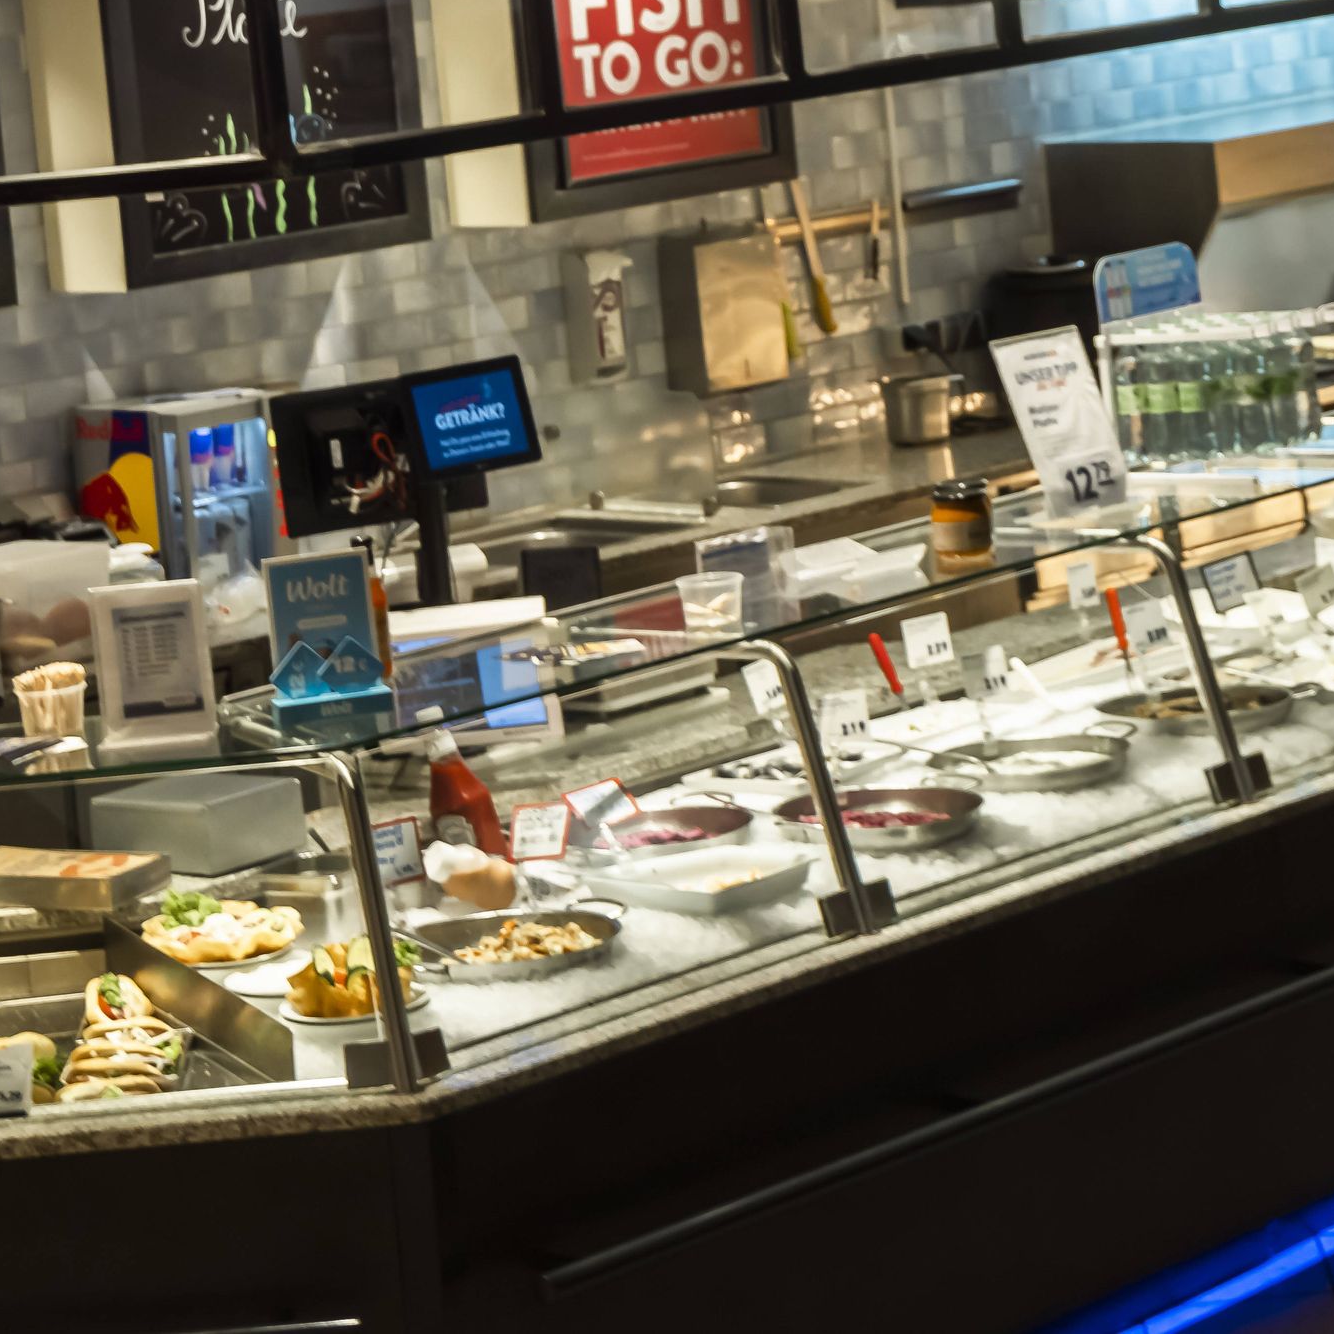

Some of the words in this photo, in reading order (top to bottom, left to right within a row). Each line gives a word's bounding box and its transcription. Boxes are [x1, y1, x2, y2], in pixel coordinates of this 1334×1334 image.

[572, 38, 641, 99] TO
[654, 29, 744, 88] GO:
[434, 401, 506, 431] GETRÄNK?
[285, 573, 349, 603] Wolt
